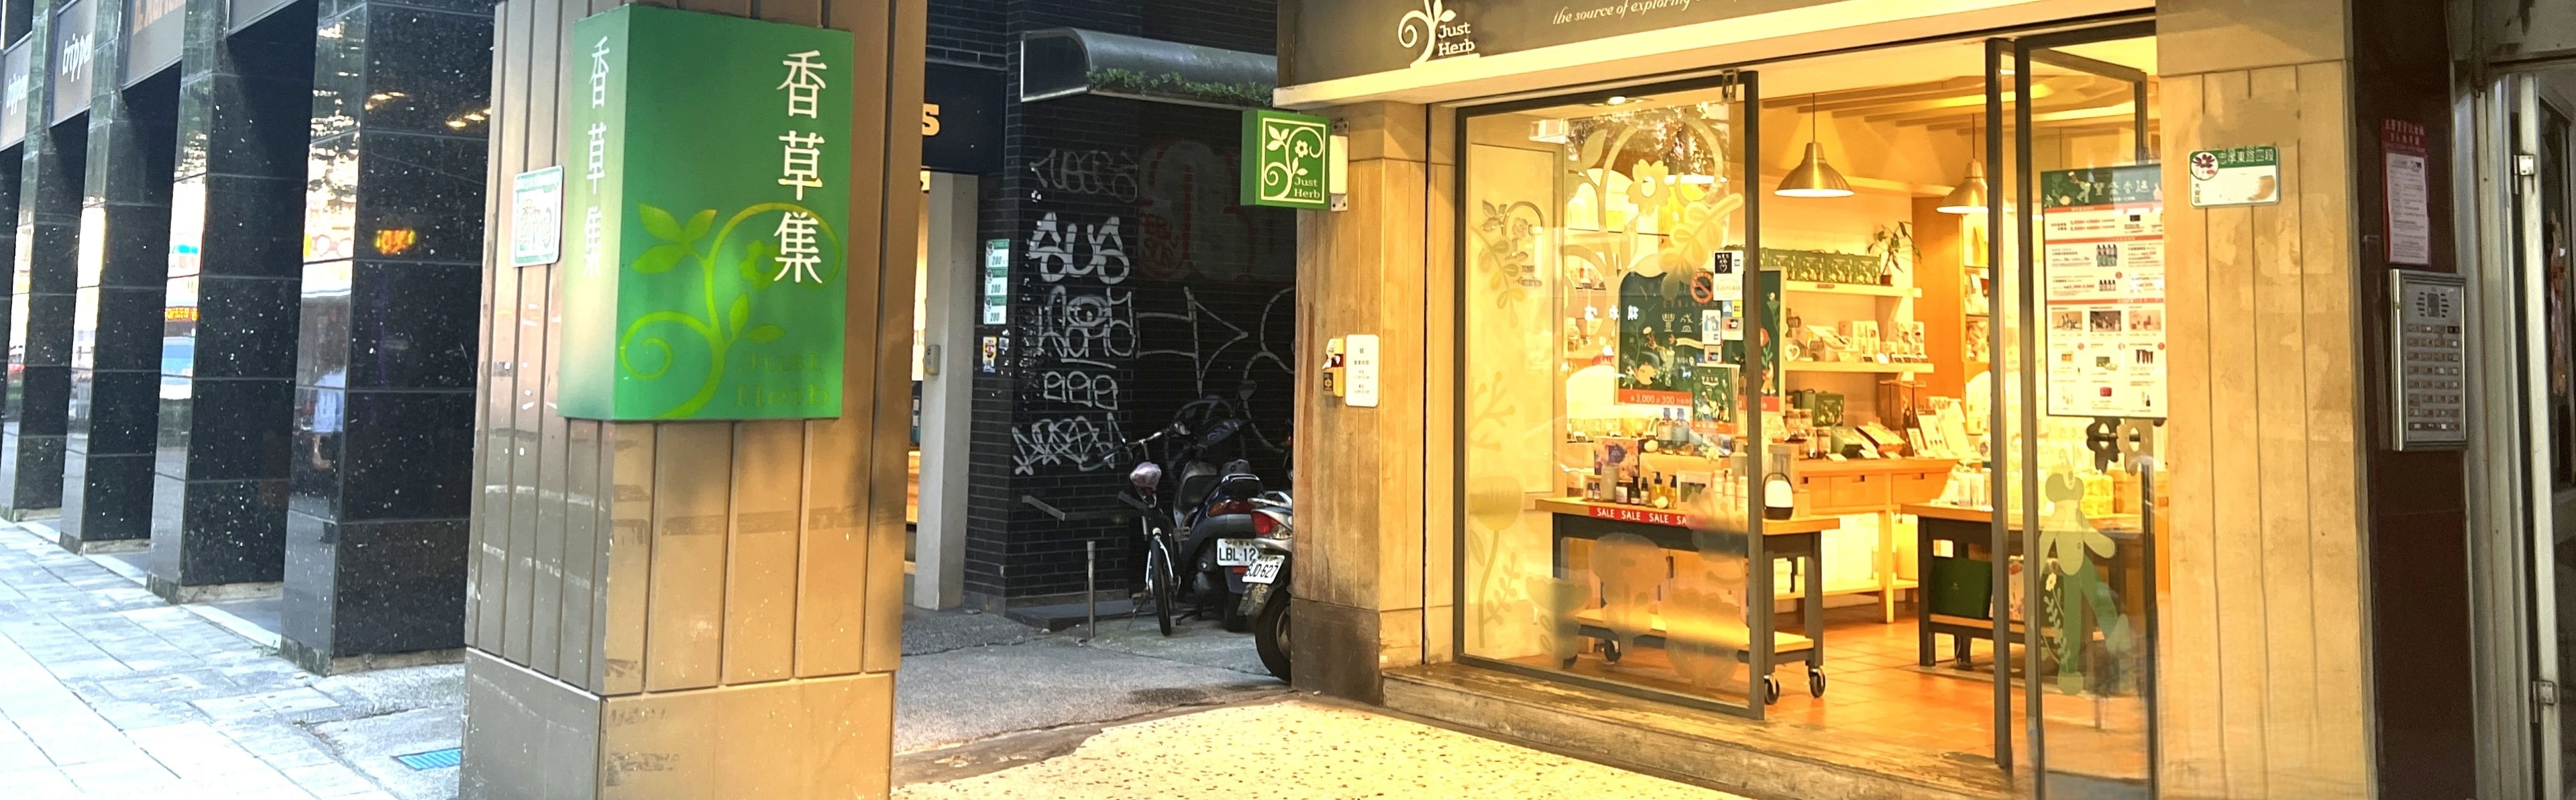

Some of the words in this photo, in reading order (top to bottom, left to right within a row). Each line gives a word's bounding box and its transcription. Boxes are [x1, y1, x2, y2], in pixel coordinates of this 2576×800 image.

[1552, 5, 1572, 25] the
[1574, 6, 1614, 21] source
[1616, 0, 1629, 20] of
[1438, 21, 1471, 39] Just
[1438, 38, 1476, 56] Herb
[582, 36, 610, 277] 香草集
[774, 50, 827, 285] 香草集
[1294, 177, 1318, 187] Just
[1294, 189, 1320, 199] Herb
[739, 351, 822, 372] Just
[737, 383, 830, 409] Herb
[1597, 507, 1615, 517] SALE
[1621, 510, 1641, 521] SALE
[1649, 513, 1669, 523] SALE
[1676, 515, 1687, 525] SA
[1219, 548, 1256, 562] LBL-12
